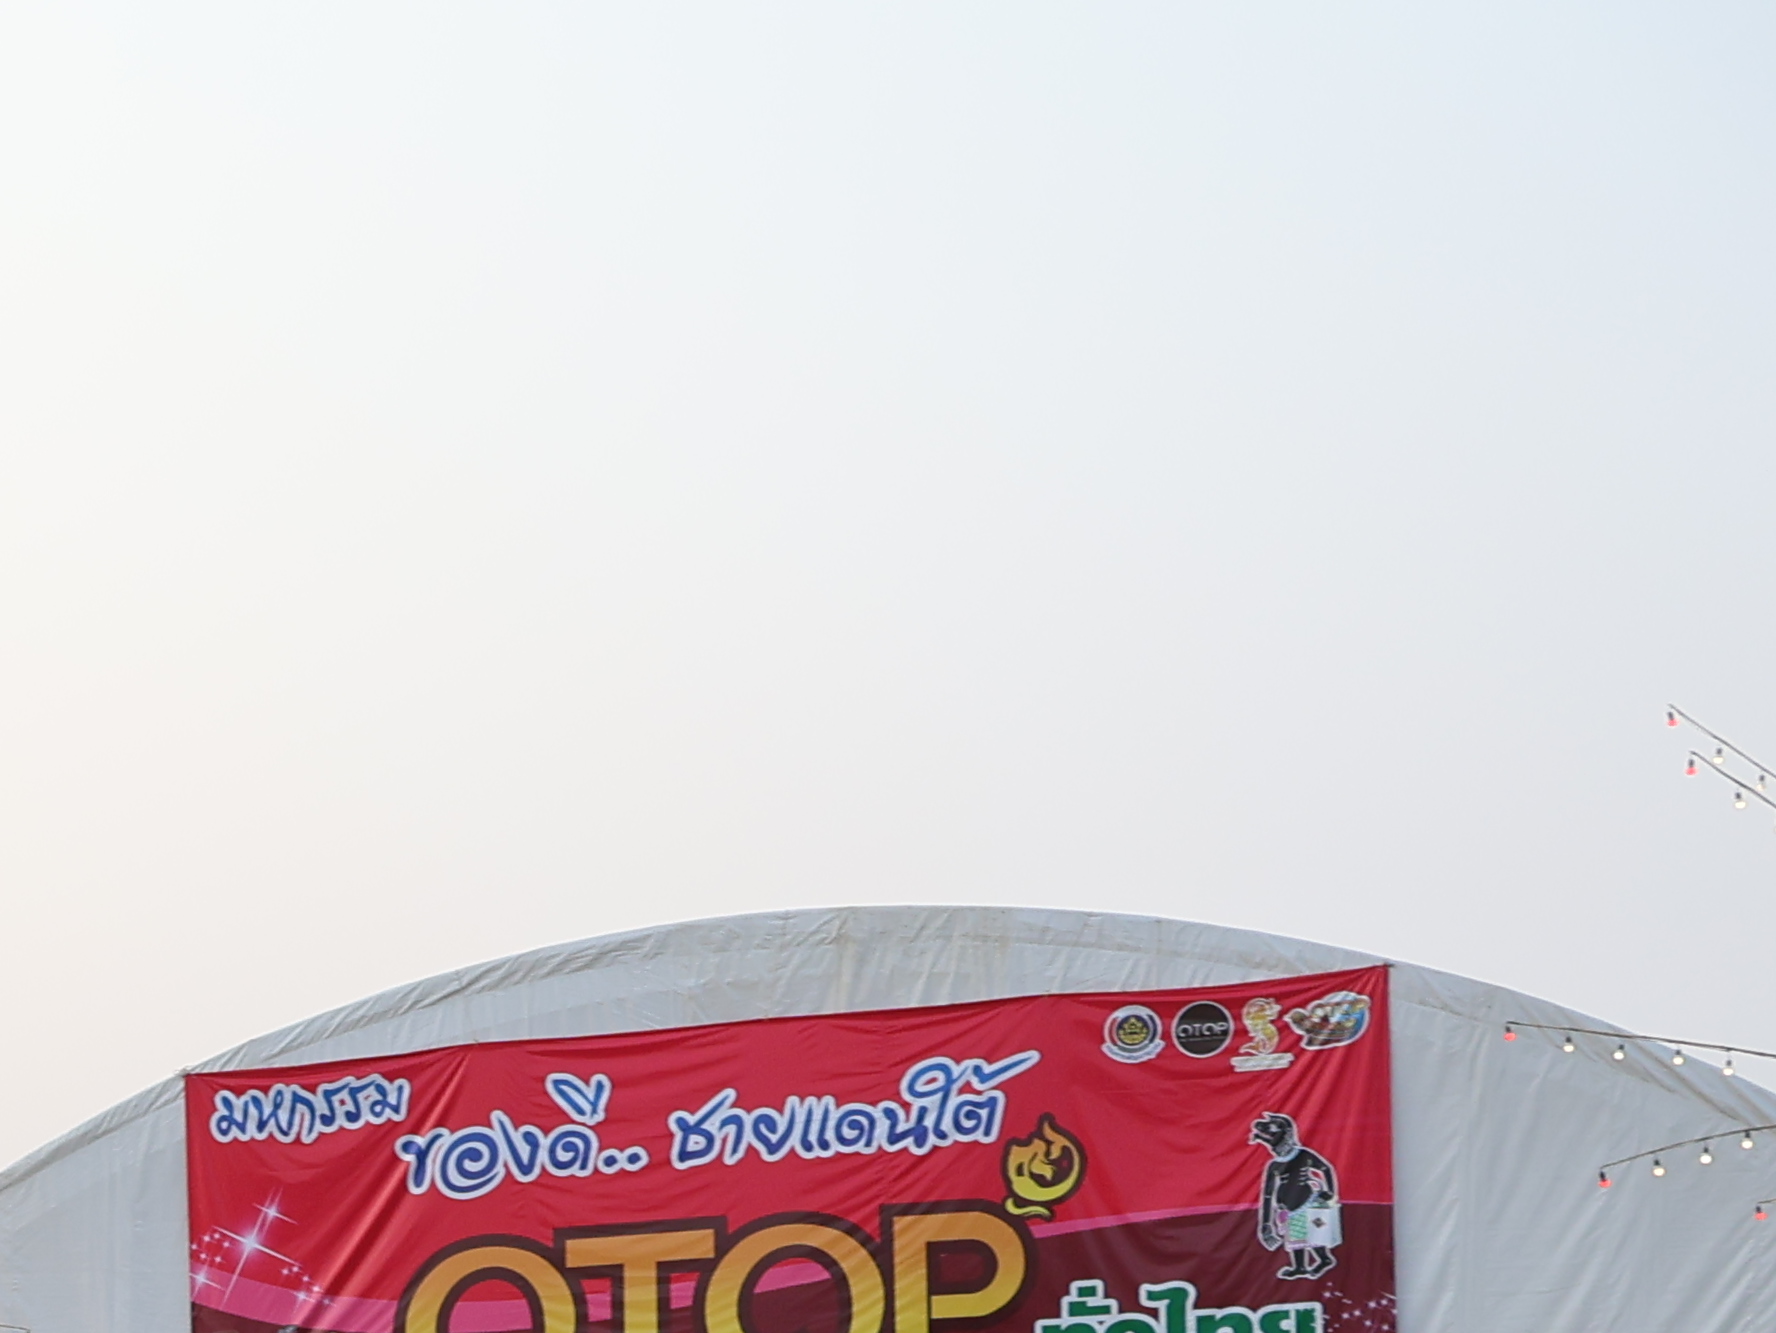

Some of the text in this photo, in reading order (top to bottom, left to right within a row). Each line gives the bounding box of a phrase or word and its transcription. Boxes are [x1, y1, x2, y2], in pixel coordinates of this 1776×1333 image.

[212, 1076, 411, 1143] มหกรรม
[667, 1050, 1041, 1171] ชายแดนใต้
